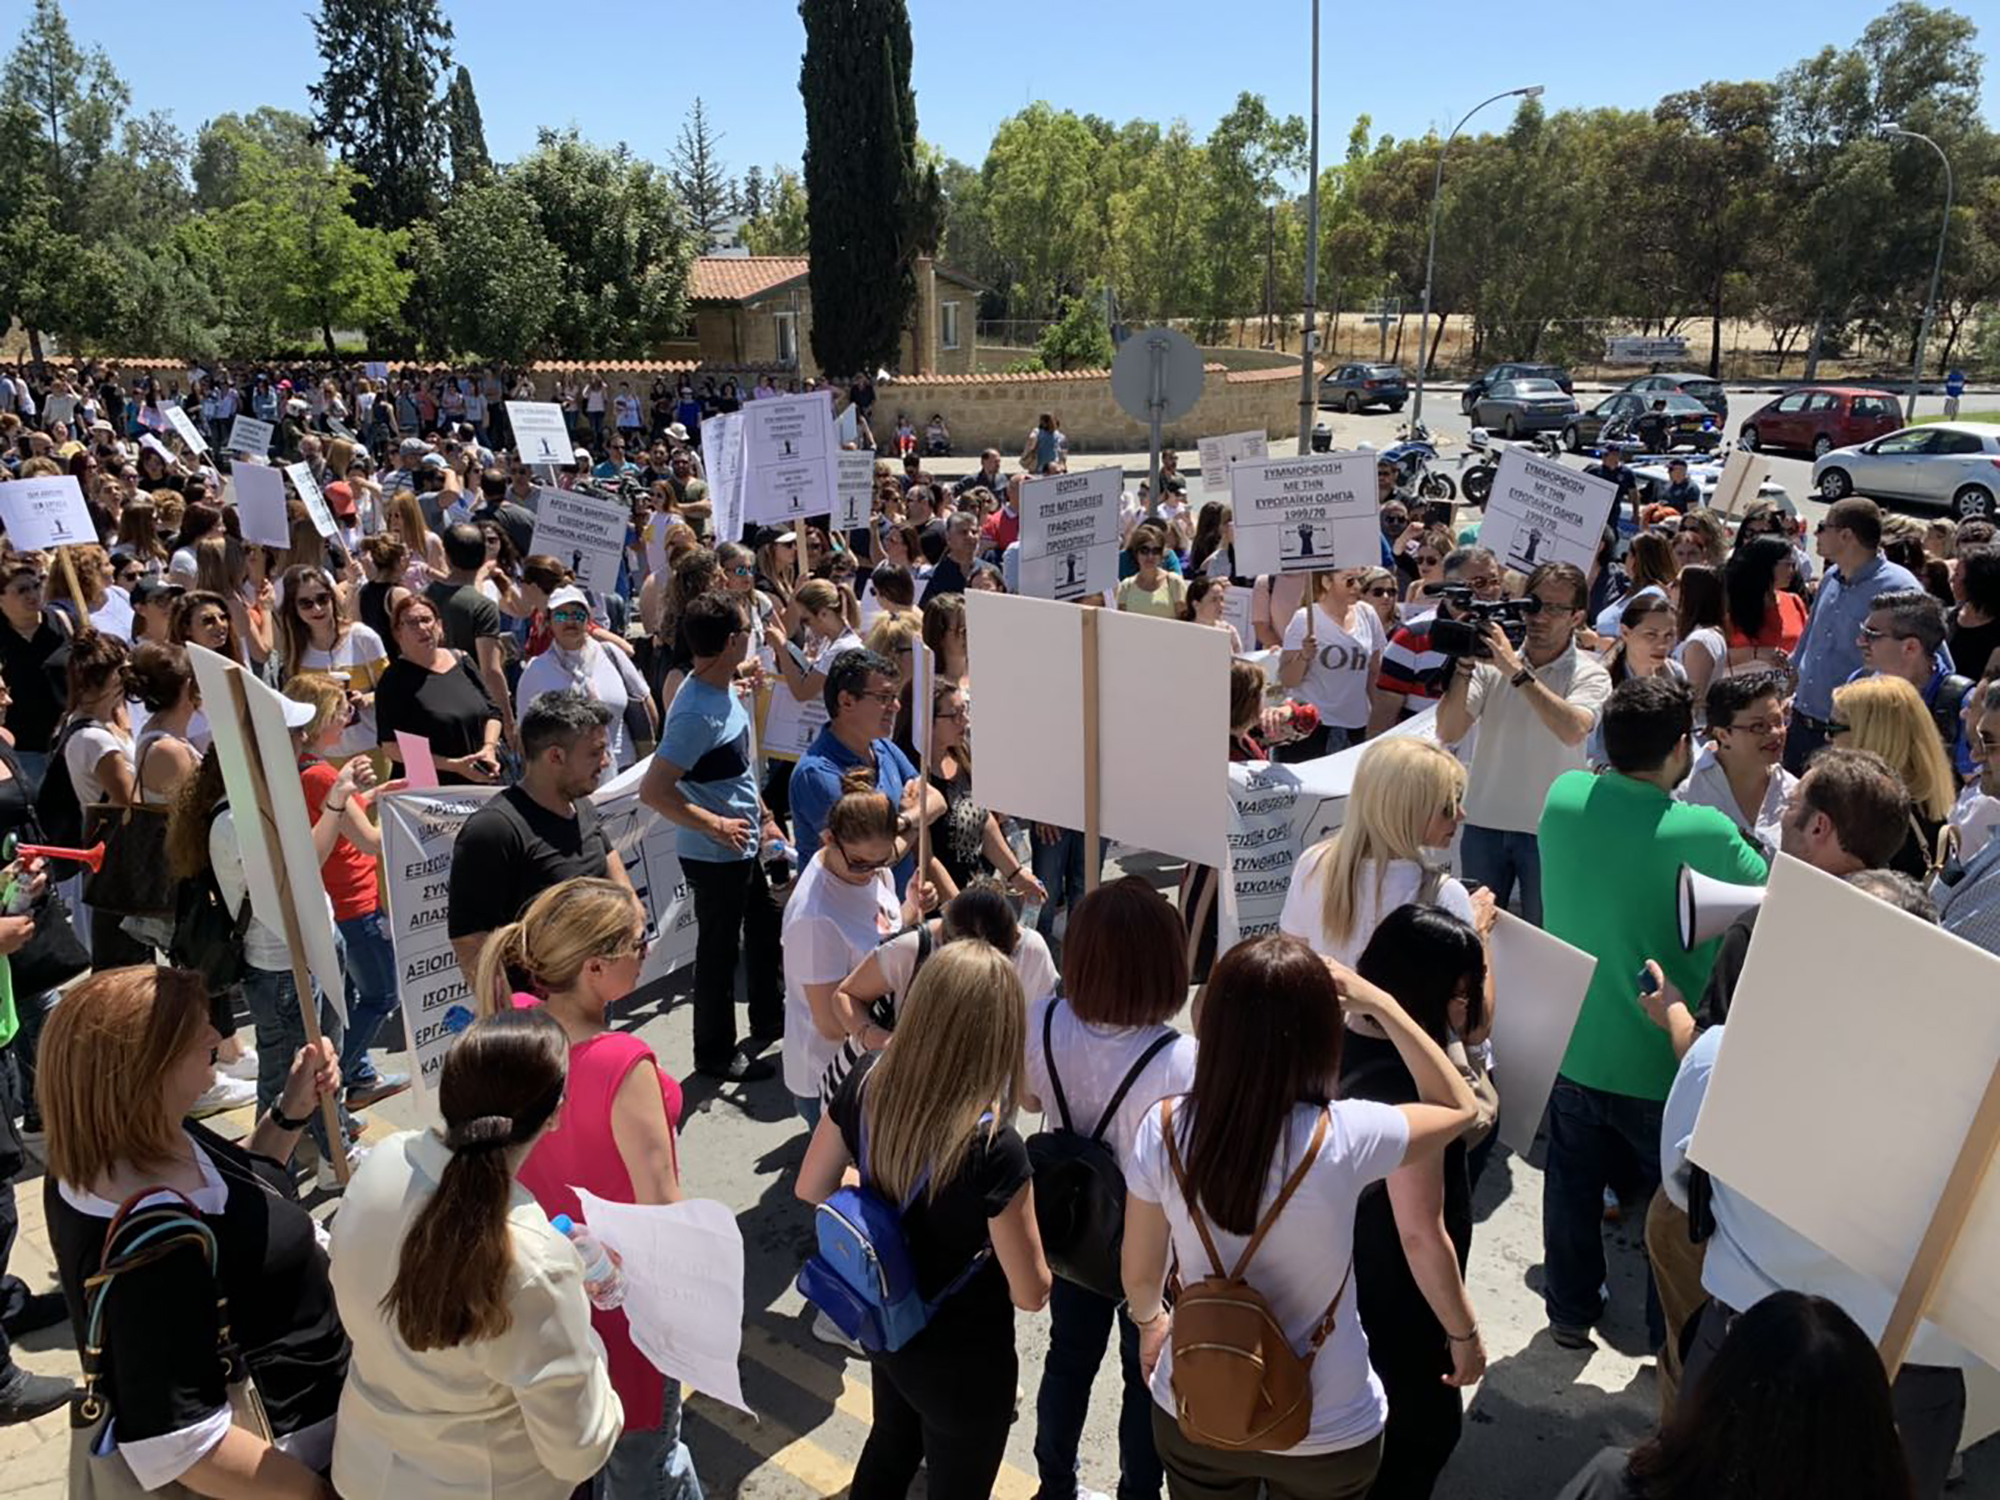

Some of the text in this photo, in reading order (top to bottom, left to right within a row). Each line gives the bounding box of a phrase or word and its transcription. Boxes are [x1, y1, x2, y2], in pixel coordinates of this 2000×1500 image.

[1264, 463, 1342, 479] ΣΥΜΜΟΡΦΩΣΗ
[1284, 480, 1324, 491] ΜΕ ΤΗΝ
[1535, 482, 1566, 501] ΜΕ ΤΗΝ
[1285, 508, 1326, 520] 1999/70
[1320, 644, 1367, 670] Oh
